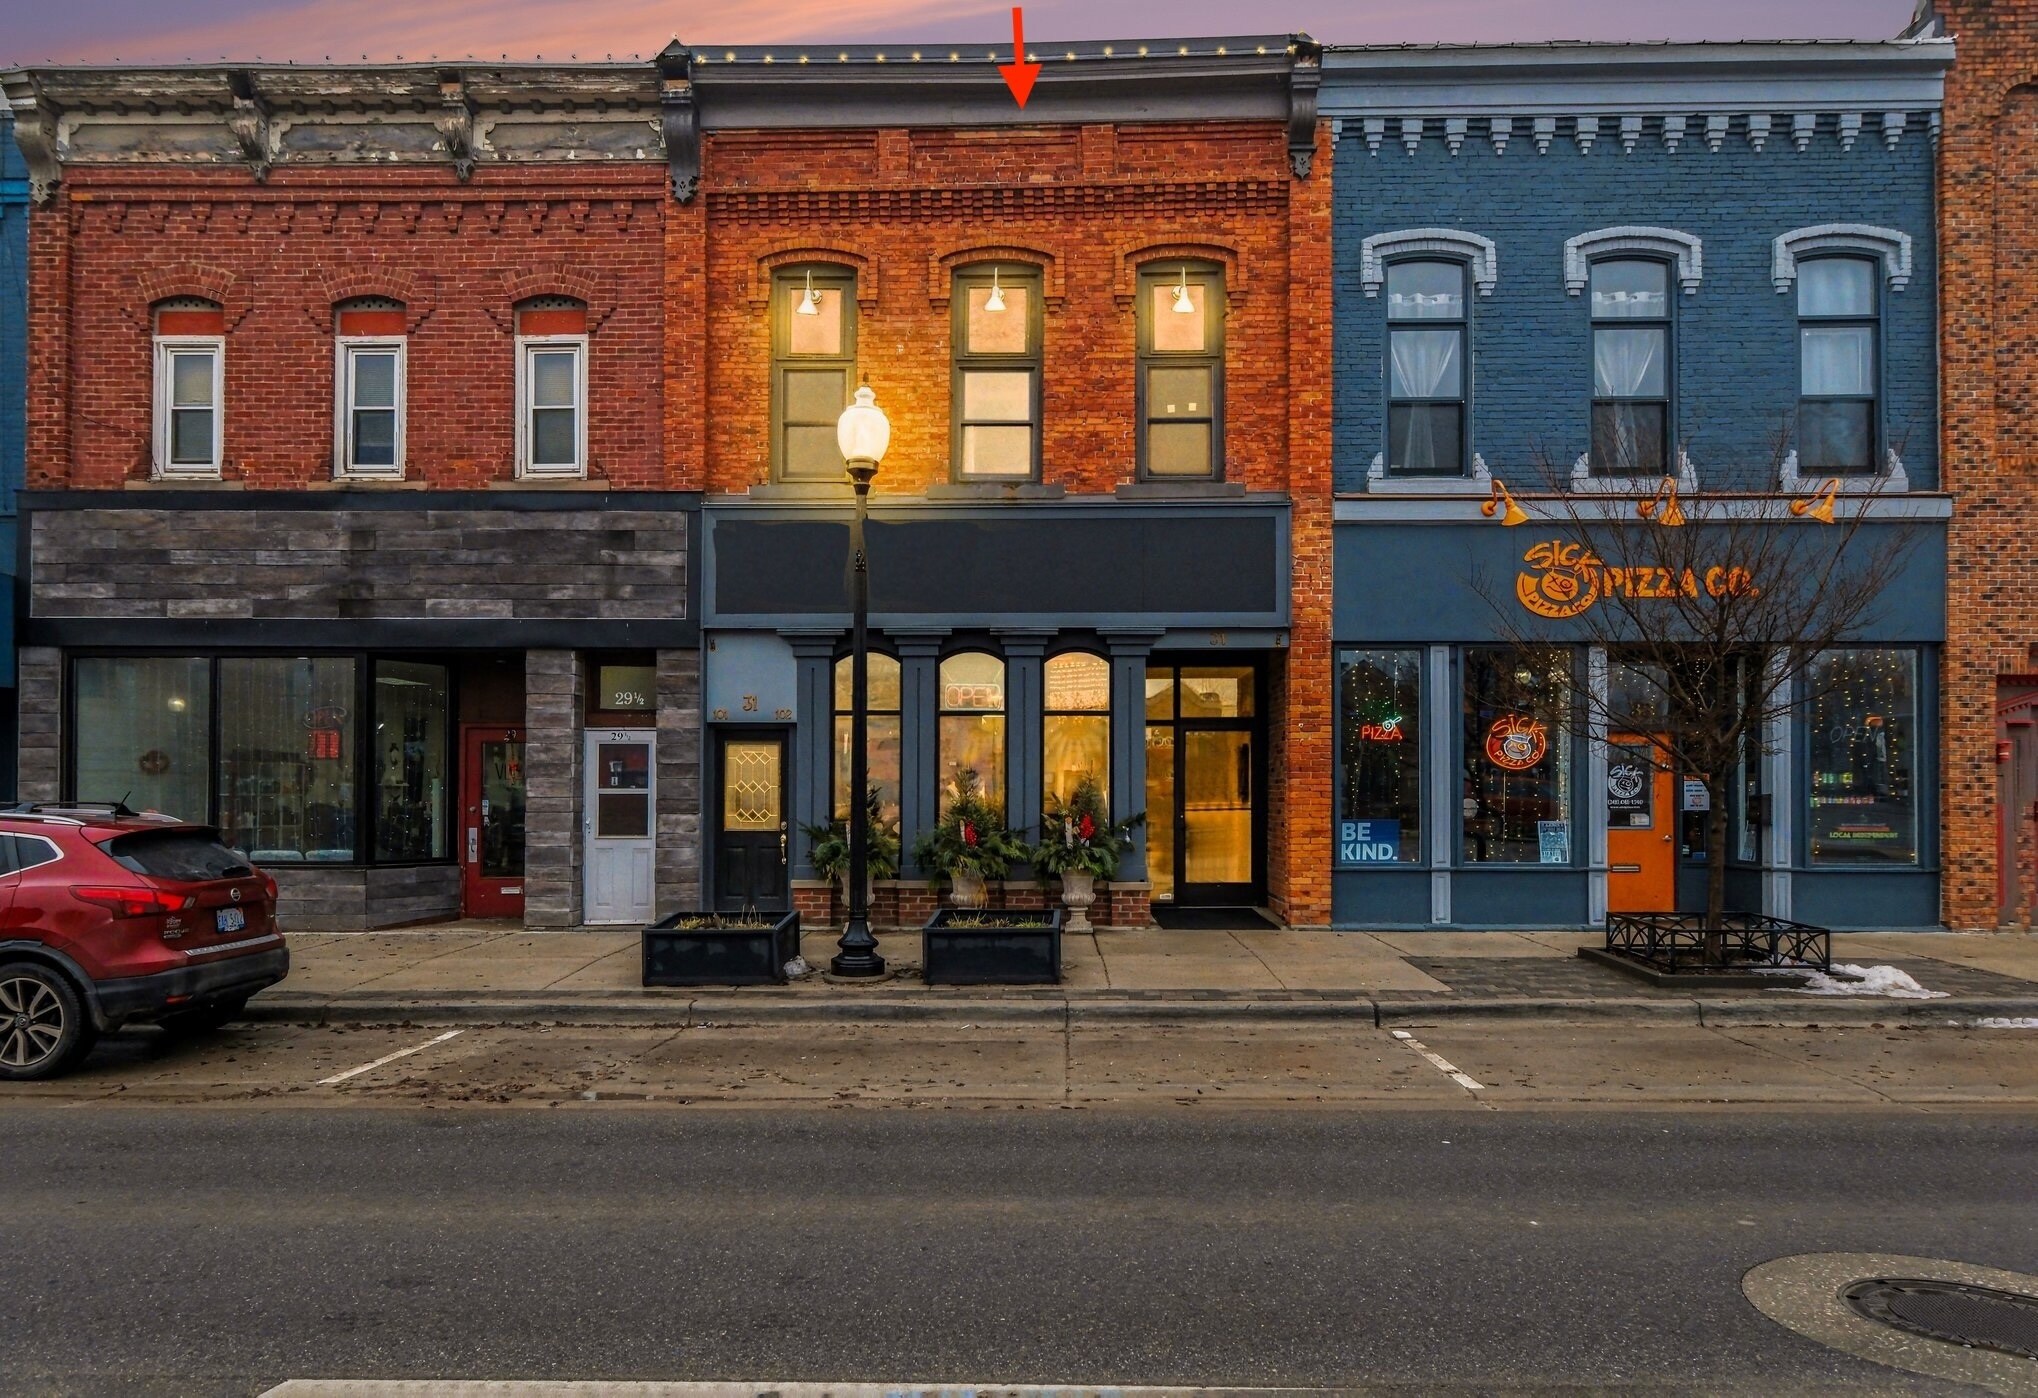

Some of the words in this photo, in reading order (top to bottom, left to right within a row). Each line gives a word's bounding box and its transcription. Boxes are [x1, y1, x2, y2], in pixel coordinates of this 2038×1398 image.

[1523, 540, 1604, 583] SICK
[1603, 566, 1699, 598] PIZZA
[1528, 590, 1570, 617] PIZZA
[743, 695, 758, 712] 31
[946, 686, 1001, 707] OPEN
[713, 709, 728, 720] 101
[775, 709, 793, 720] 102
[1361, 725, 1401, 740] PIZZA
[1491, 714, 1548, 743] SICK
[1830, 726, 1879, 743] OPEN
[1494, 751, 1524, 767] PIZZA
[1609, 763, 1644, 783] SICK
[1612, 785, 1630, 797] PIZZA
[1341, 822, 1371, 841] BE
[1341, 843, 1398, 861] KIND.
